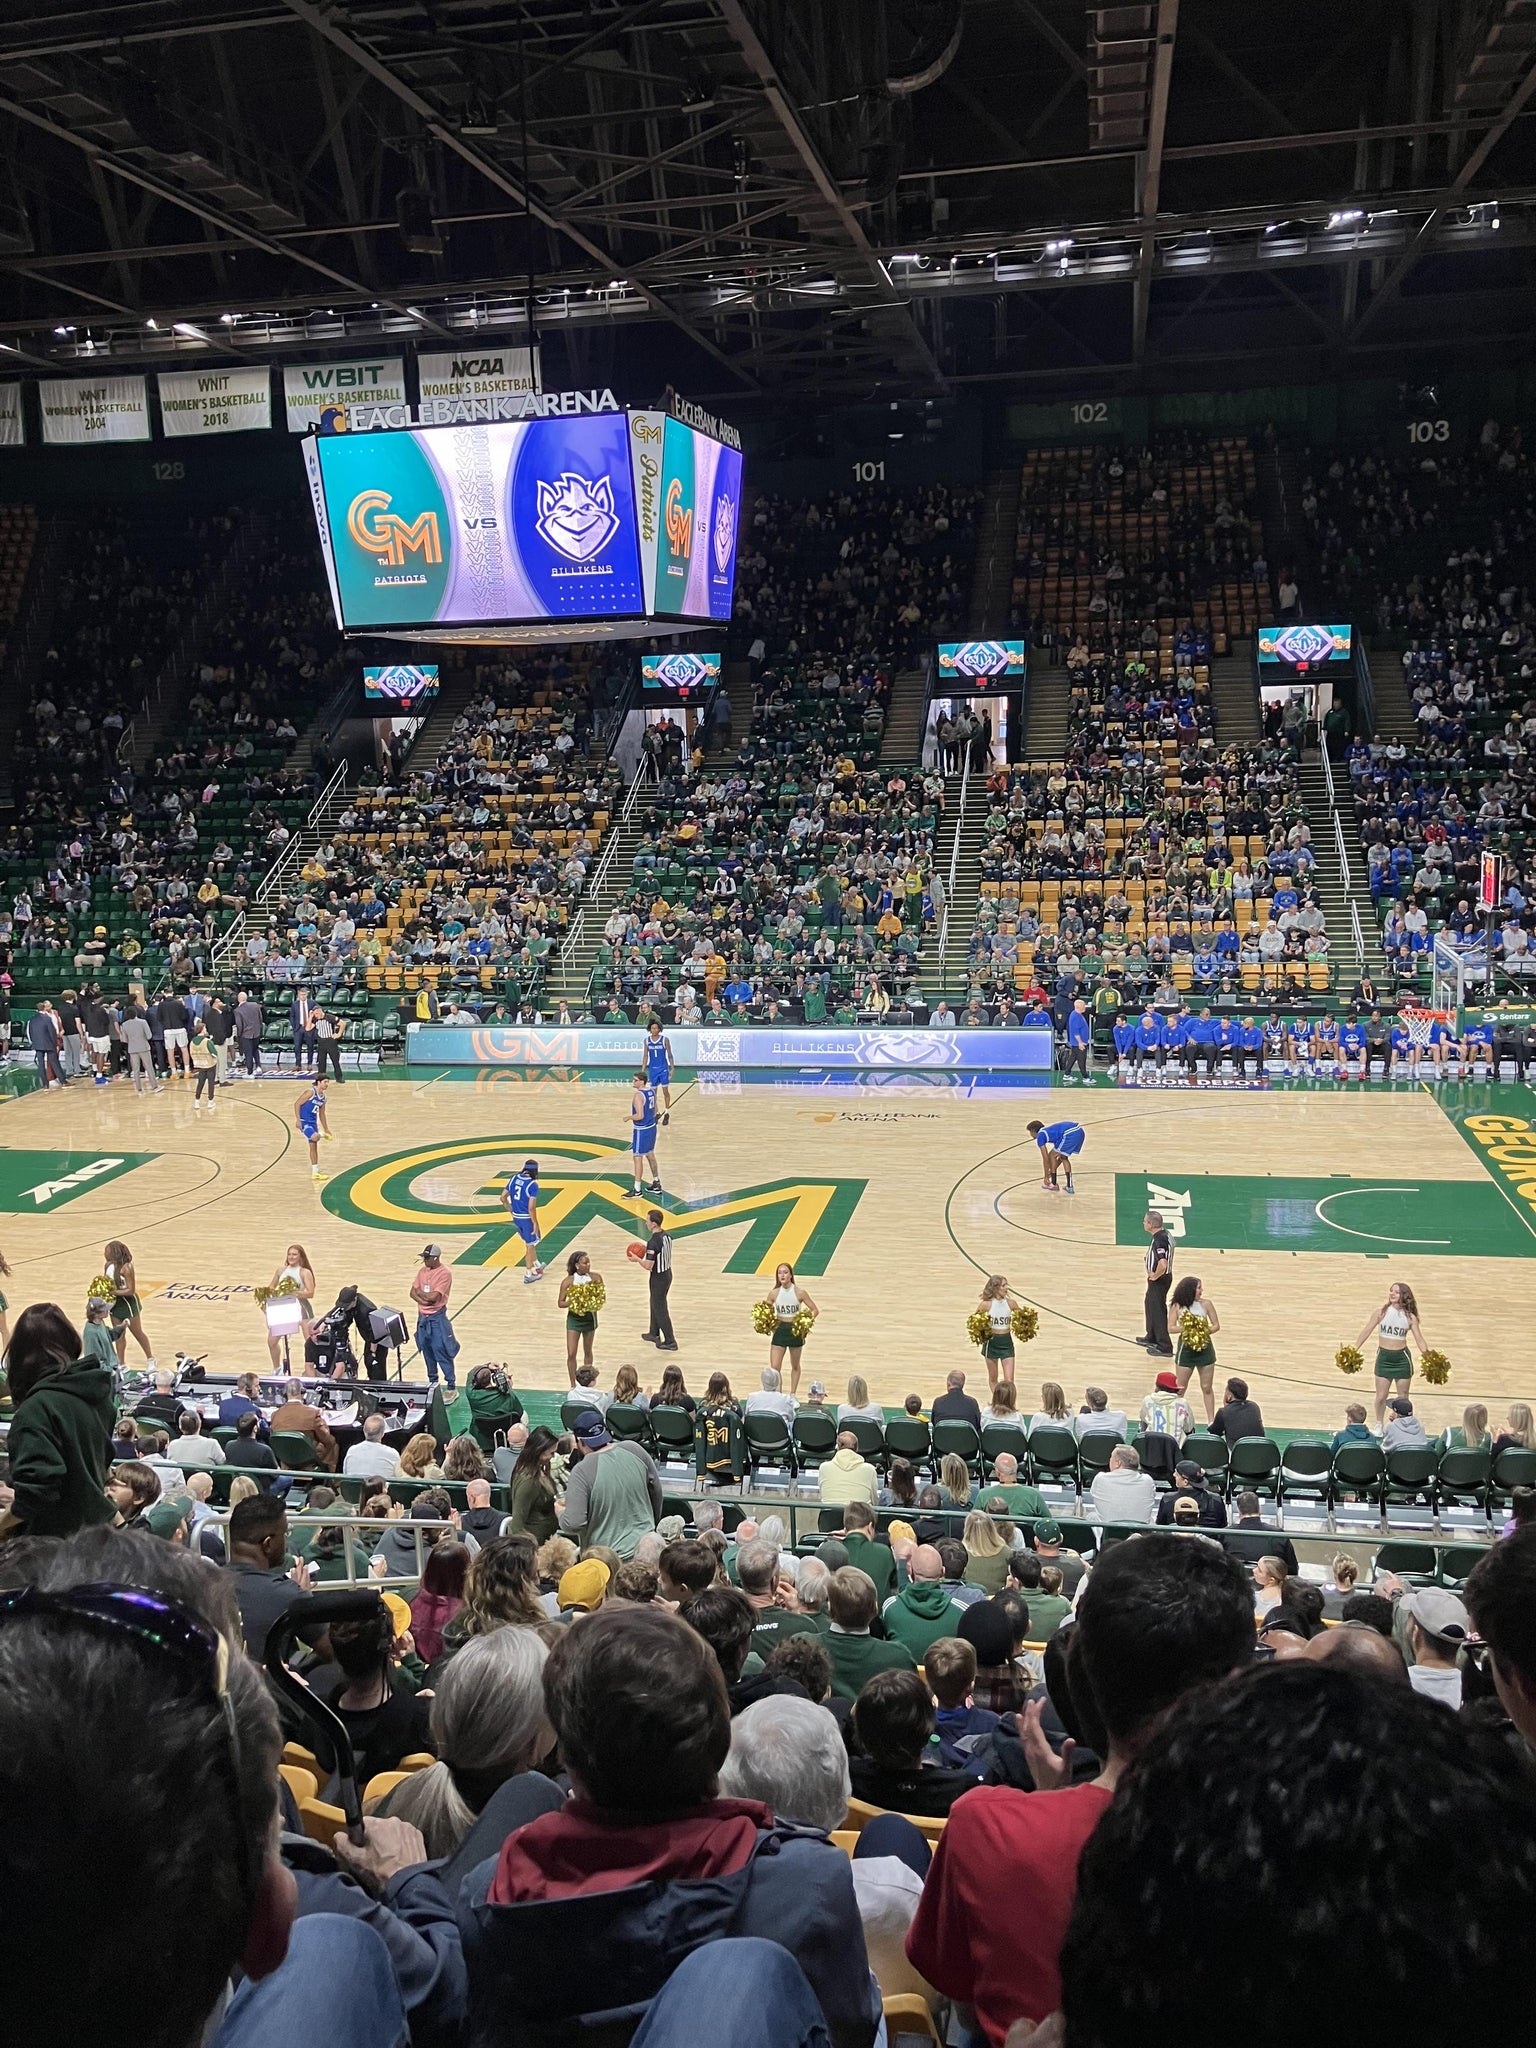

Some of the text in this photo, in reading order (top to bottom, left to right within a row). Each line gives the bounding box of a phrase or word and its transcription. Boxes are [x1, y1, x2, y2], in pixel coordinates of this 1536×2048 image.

[451, 358, 504, 378] NCAA
[198, 377, 230, 392] WNIT
[303, 366, 384, 388] WBIT
[422, 377, 539, 396] WOMEN'S BASKETBALL
[79, 389, 106, 401] WNIT
[163, 393, 266, 411] WOMEN'S BASKETBALL
[288, 388, 401, 407] WOMEN'S BASKETBALL
[518, 388, 619, 418] ARENA
[203, 414, 228, 427] 2018
[1070, 402, 1108, 424] 102
[85, 417, 106, 430] 2004
[632, 416, 661, 444] GM
[1407, 419, 1451, 444] 103
[152, 462, 185, 480] 128
[852, 460, 886, 482] 101
[640, 454, 658, 543] Patriots
[348, 489, 442, 565] GM
[464, 517, 497, 529] VS
[551, 564, 613, 575] BILLIKENS
[374, 575, 426, 584] PATRIOTS
[992, 678, 998, 686] 2
[1500, 1012, 1531, 1021] Sentara
[654, 1049, 658, 1058] 1
[773, 1042, 855, 1052] BILLIKENS
[513, 1186, 521, 1200] 3
[153, 1291, 230, 1302] ARENA
[1380, 1324, 1406, 1337] MASO
